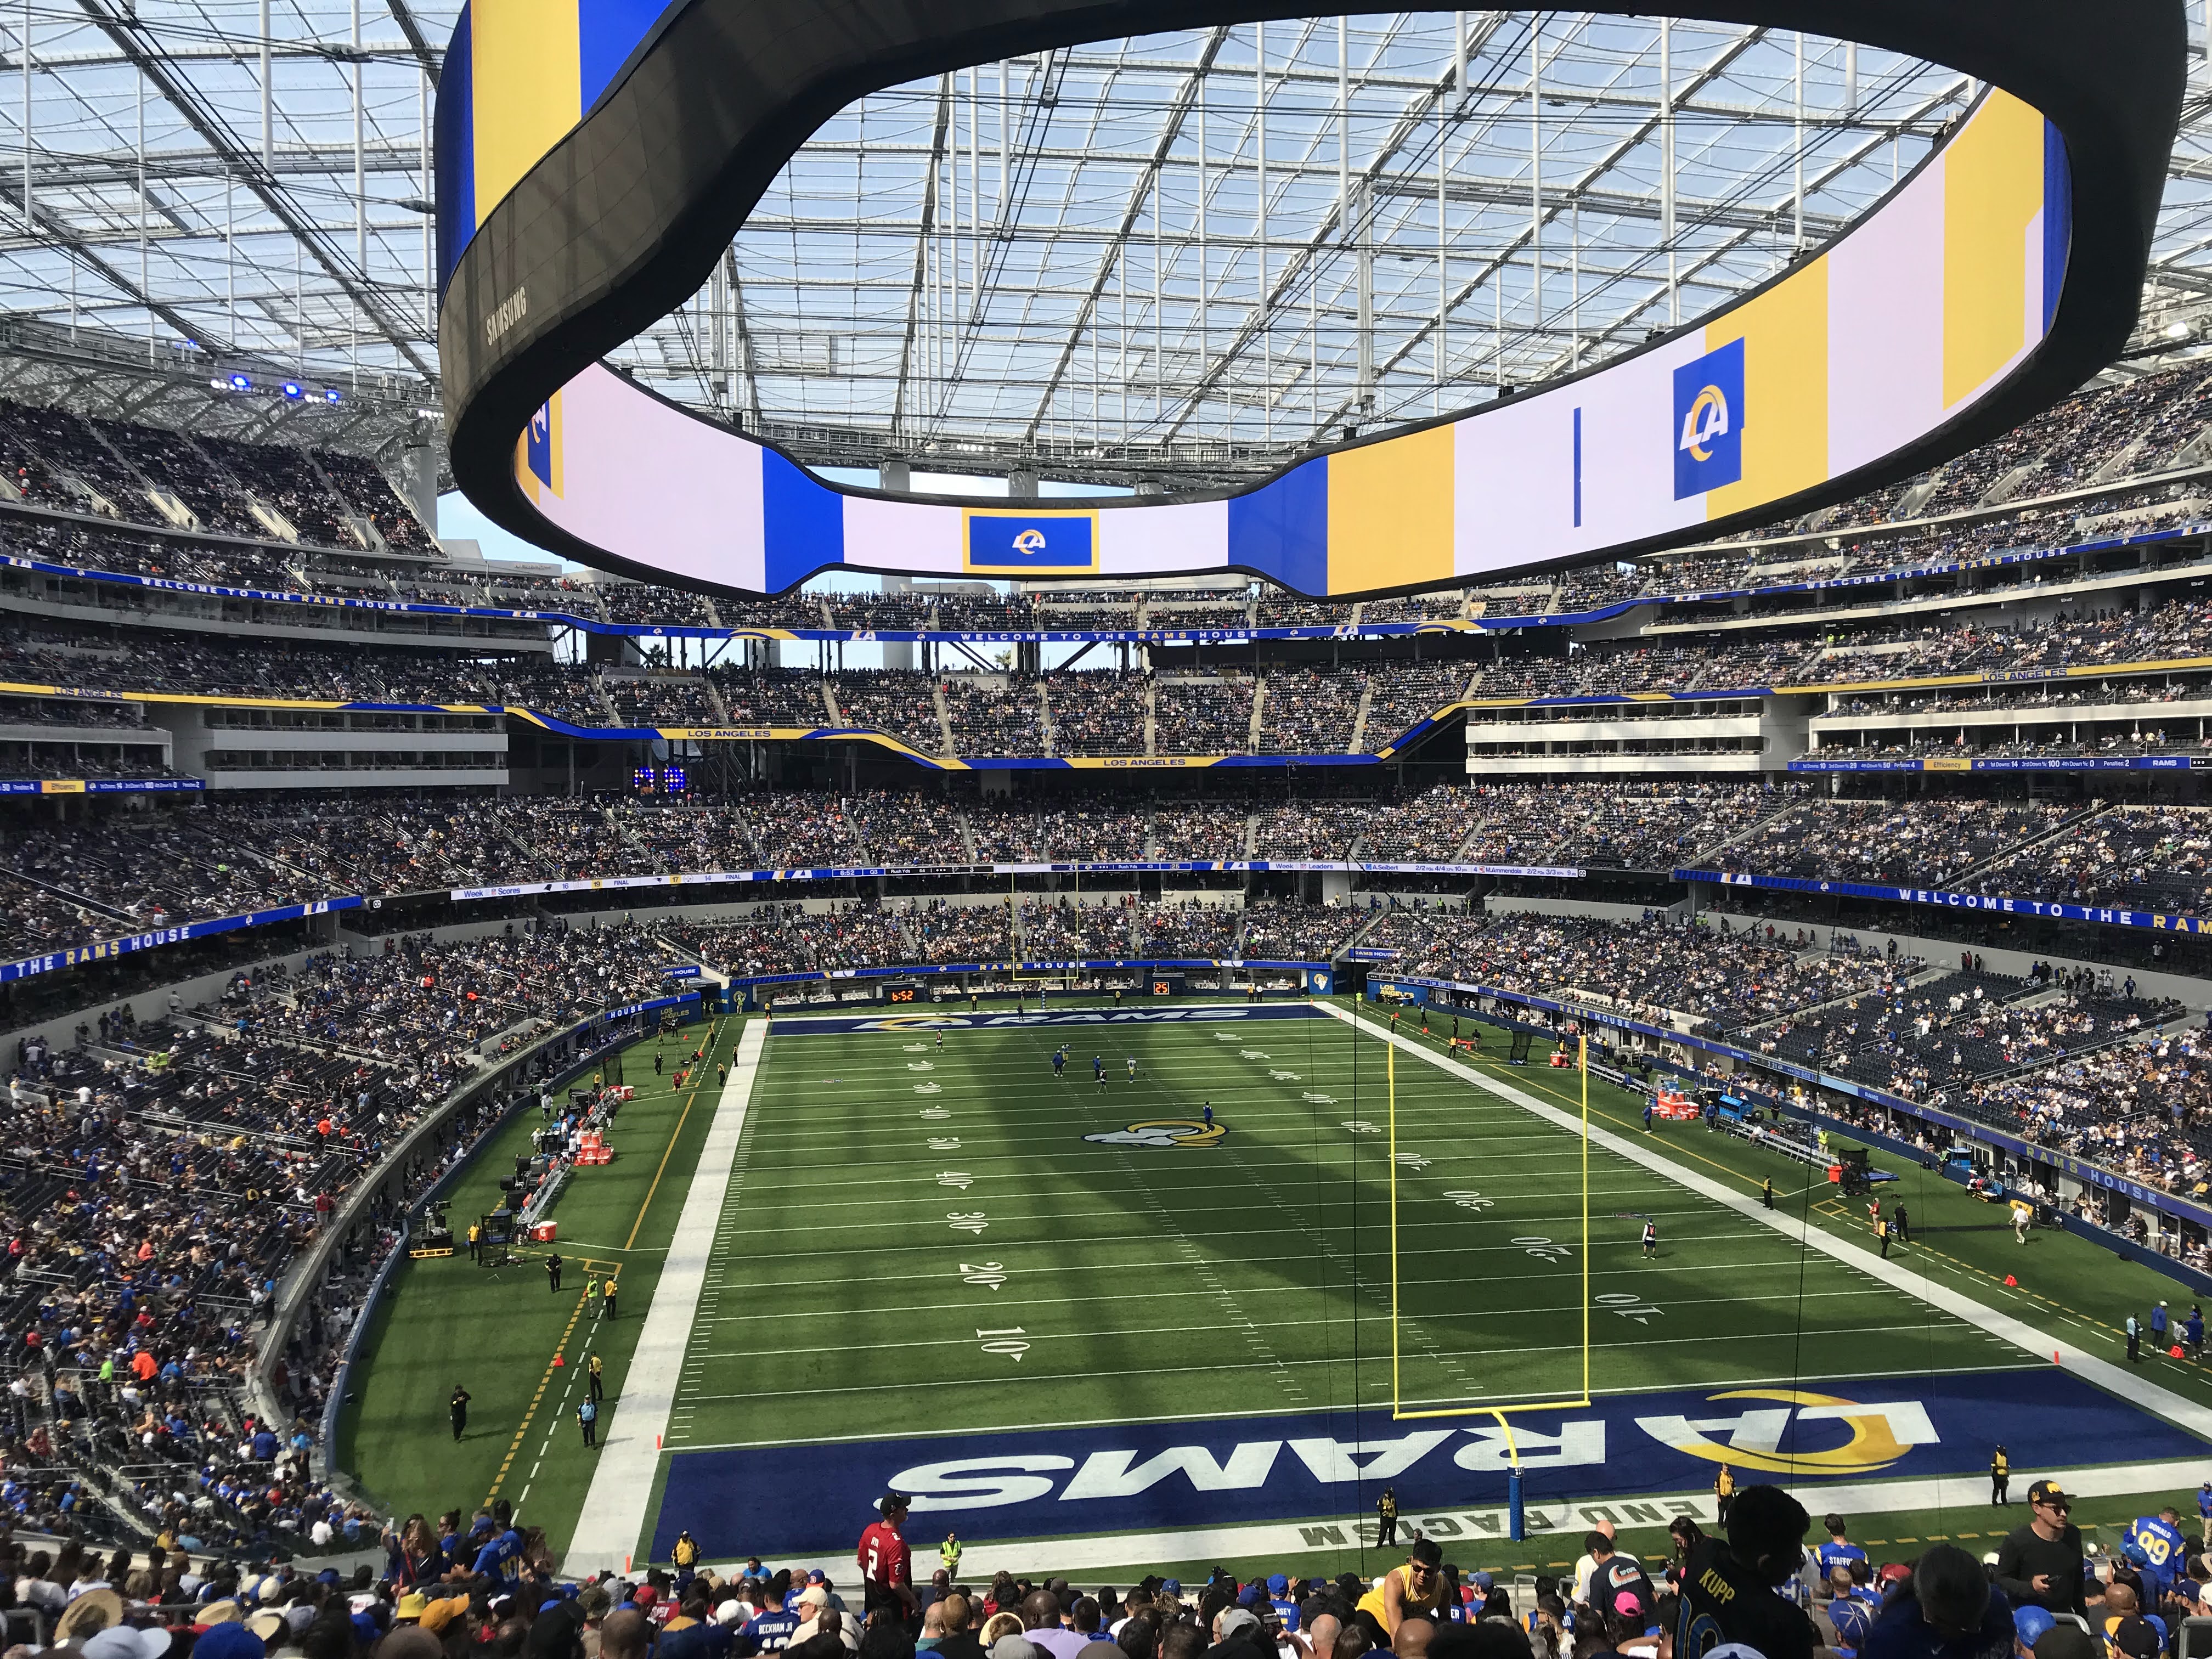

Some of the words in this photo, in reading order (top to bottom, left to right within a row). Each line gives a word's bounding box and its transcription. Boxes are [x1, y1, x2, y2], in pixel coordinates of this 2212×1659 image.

[487, 286, 527, 346] SAMSUNG
[1807, 577, 1886, 589] WELCOME
[1922, 566, 1948, 575] THE
[1959, 557, 2002, 570] RAMS
[2013, 547, 2067, 562] HOUSE
[141, 577, 217, 594] WELCOME
[228, 589, 248, 597] TO
[261, 592, 290, 601] THE
[302, 595, 346, 606] RAMS
[356, 600, 409, 610] HOUSE
[1982, 673, 2006, 682] LOS
[2009, 669, 2067, 680] ANGELES
[464, 890, 483, 898] Week
[1899, 889, 2013, 912] WELCOME
[2033, 902, 2062, 917] TO
[2083, 907, 2132, 926] THE
[16, 956, 53, 977] THE
[66, 941, 119, 965] RAMS
[132, 927, 189, 950] HOUSE
[892, 990, 913, 1001] 6:52
[1155, 984, 1167, 993] 25
[611, 1005, 642, 1019] HOUSE
[983, 1010, 1249, 1025] RAMS
[1560, 1005, 1588, 1018] RAMS
[1595, 1013, 1630, 1028] HOUSE
[927, 1137, 962, 1149] 50
[1388, 1153, 1432, 1167] 40
[935, 1171, 974, 1186] 40
[2027, 1143, 2078, 1173] RAMS
[2091, 1170, 2157, 1205] HOUSE
[1443, 1190, 1494, 1209] 30
[946, 1212, 989, 1230] 30
[1510, 1237, 1572, 1257] 20
[959, 1262, 1007, 1285] 20
[1595, 1294, 1664, 1318] 10
[976, 1327, 1030, 1353] 10
[873, 1420, 1605, 1512] RAMS
[1579, 1500, 1707, 1525] END
[1298, 1510, 1555, 1547] RACISM
[2148, 1522, 2171, 1539] DONALD
[2141, 1531, 2170, 1566] 99
[1829, 1556, 1853, 1566] STAFFO
[1699, 1567, 1735, 1605] KUPP
[759, 1623, 785, 1635] BECKHAM
[786, 1622, 793, 1633] JR
